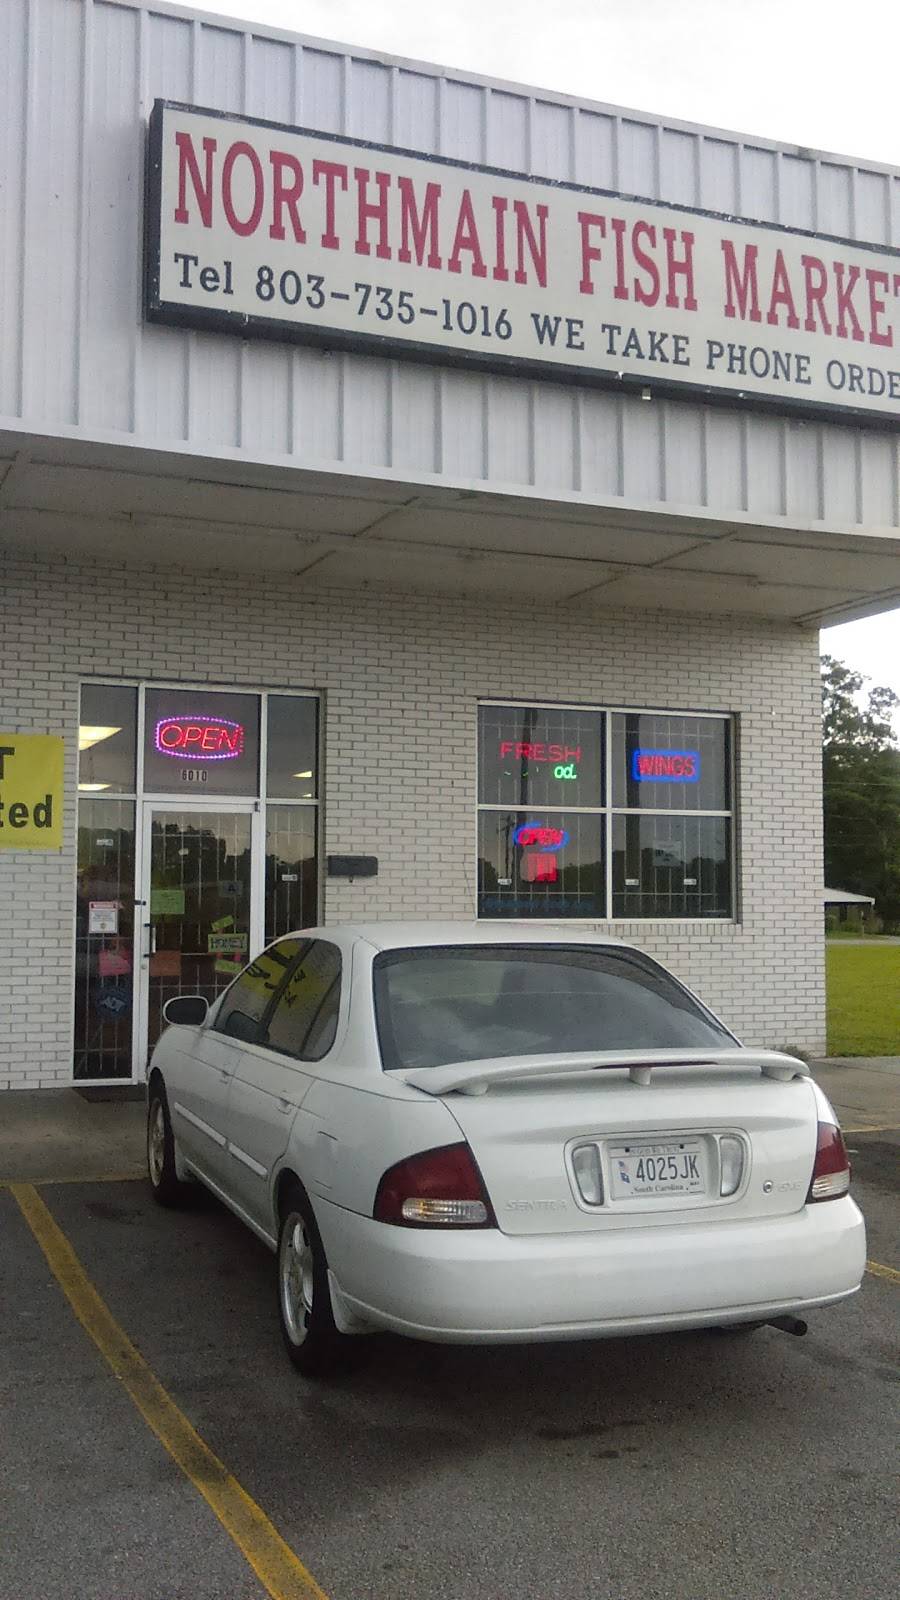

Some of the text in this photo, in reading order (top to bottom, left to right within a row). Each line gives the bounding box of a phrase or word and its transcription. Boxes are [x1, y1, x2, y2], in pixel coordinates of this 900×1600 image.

[174, 131, 549, 288] NORTHMAIN
[577, 211, 698, 311] FISH
[174, 252, 234, 295] Tel
[255, 264, 513, 340] 803-735-1016
[530, 312, 586, 351] WE
[601, 323, 690, 366] TAKE
[706, 340, 811, 385] PHONE
[160, 724, 239, 751] OPEN
[500, 742, 582, 763] FRESH
[182, 769, 207, 782] 6010
[639, 755, 695, 777] WINGS
[518, 827, 563, 847] OPEN
[636, 1155, 700, 1182] 4025JK
[634, 1184, 654, 1193] South
[655, 1183, 684, 1192] Carolina
